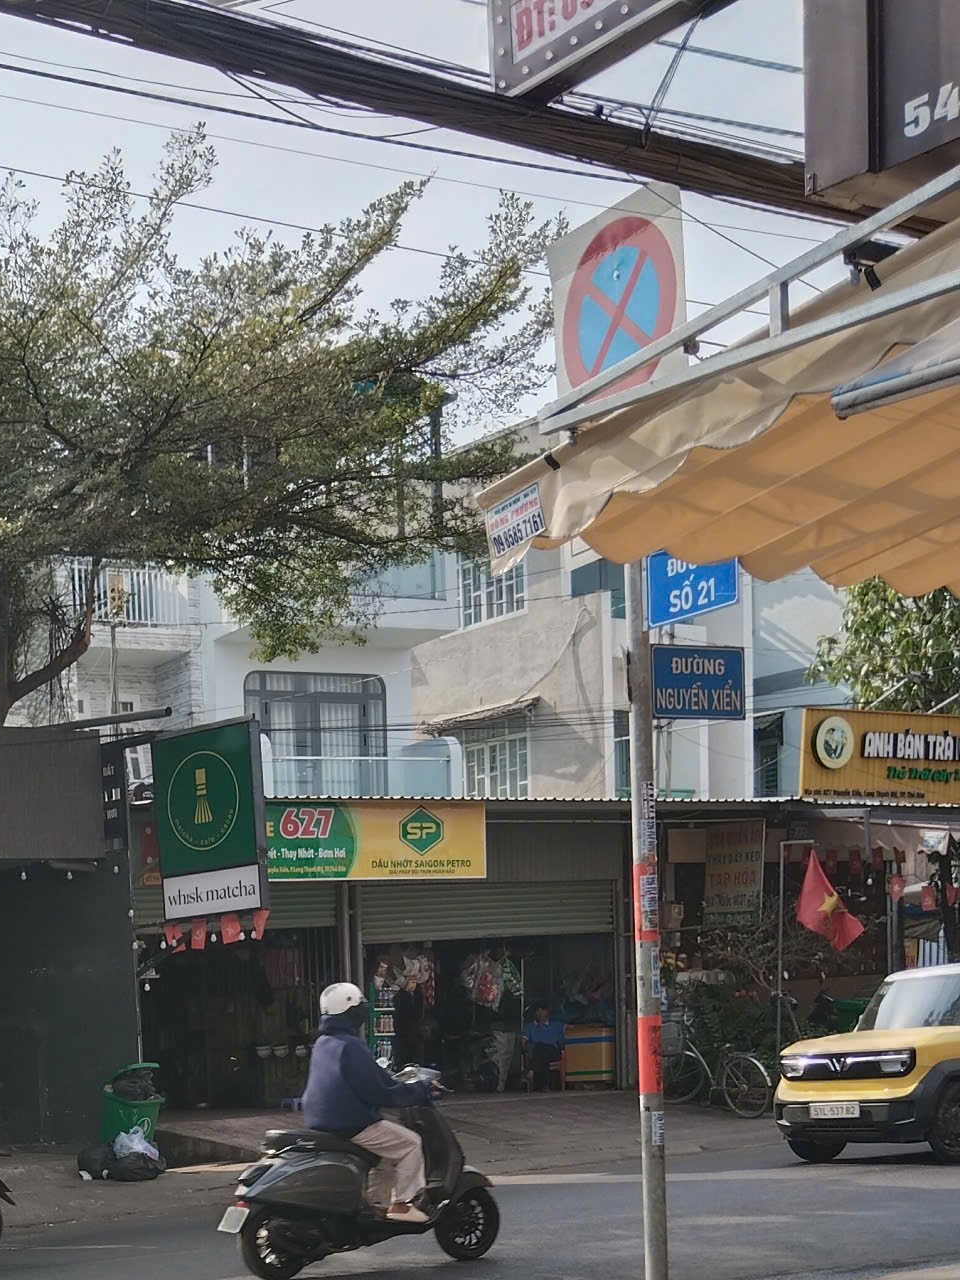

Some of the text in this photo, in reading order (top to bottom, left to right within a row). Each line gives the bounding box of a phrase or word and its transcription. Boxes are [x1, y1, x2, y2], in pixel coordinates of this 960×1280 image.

[669, 574, 715, 613] SỐ 21
[671, 655, 725, 675] ĐƯỜNG
[656, 679, 740, 711] NGUYỄN XIỂN
[863, 728, 954, 761] ANH BÁN TRÀ
[280, 808, 334, 839] 627
[407, 822, 437, 840] SP
[414, 859, 444, 869] SAIGON
[446, 859, 471, 868] PETRO
[206, 880, 256, 902] matcha
